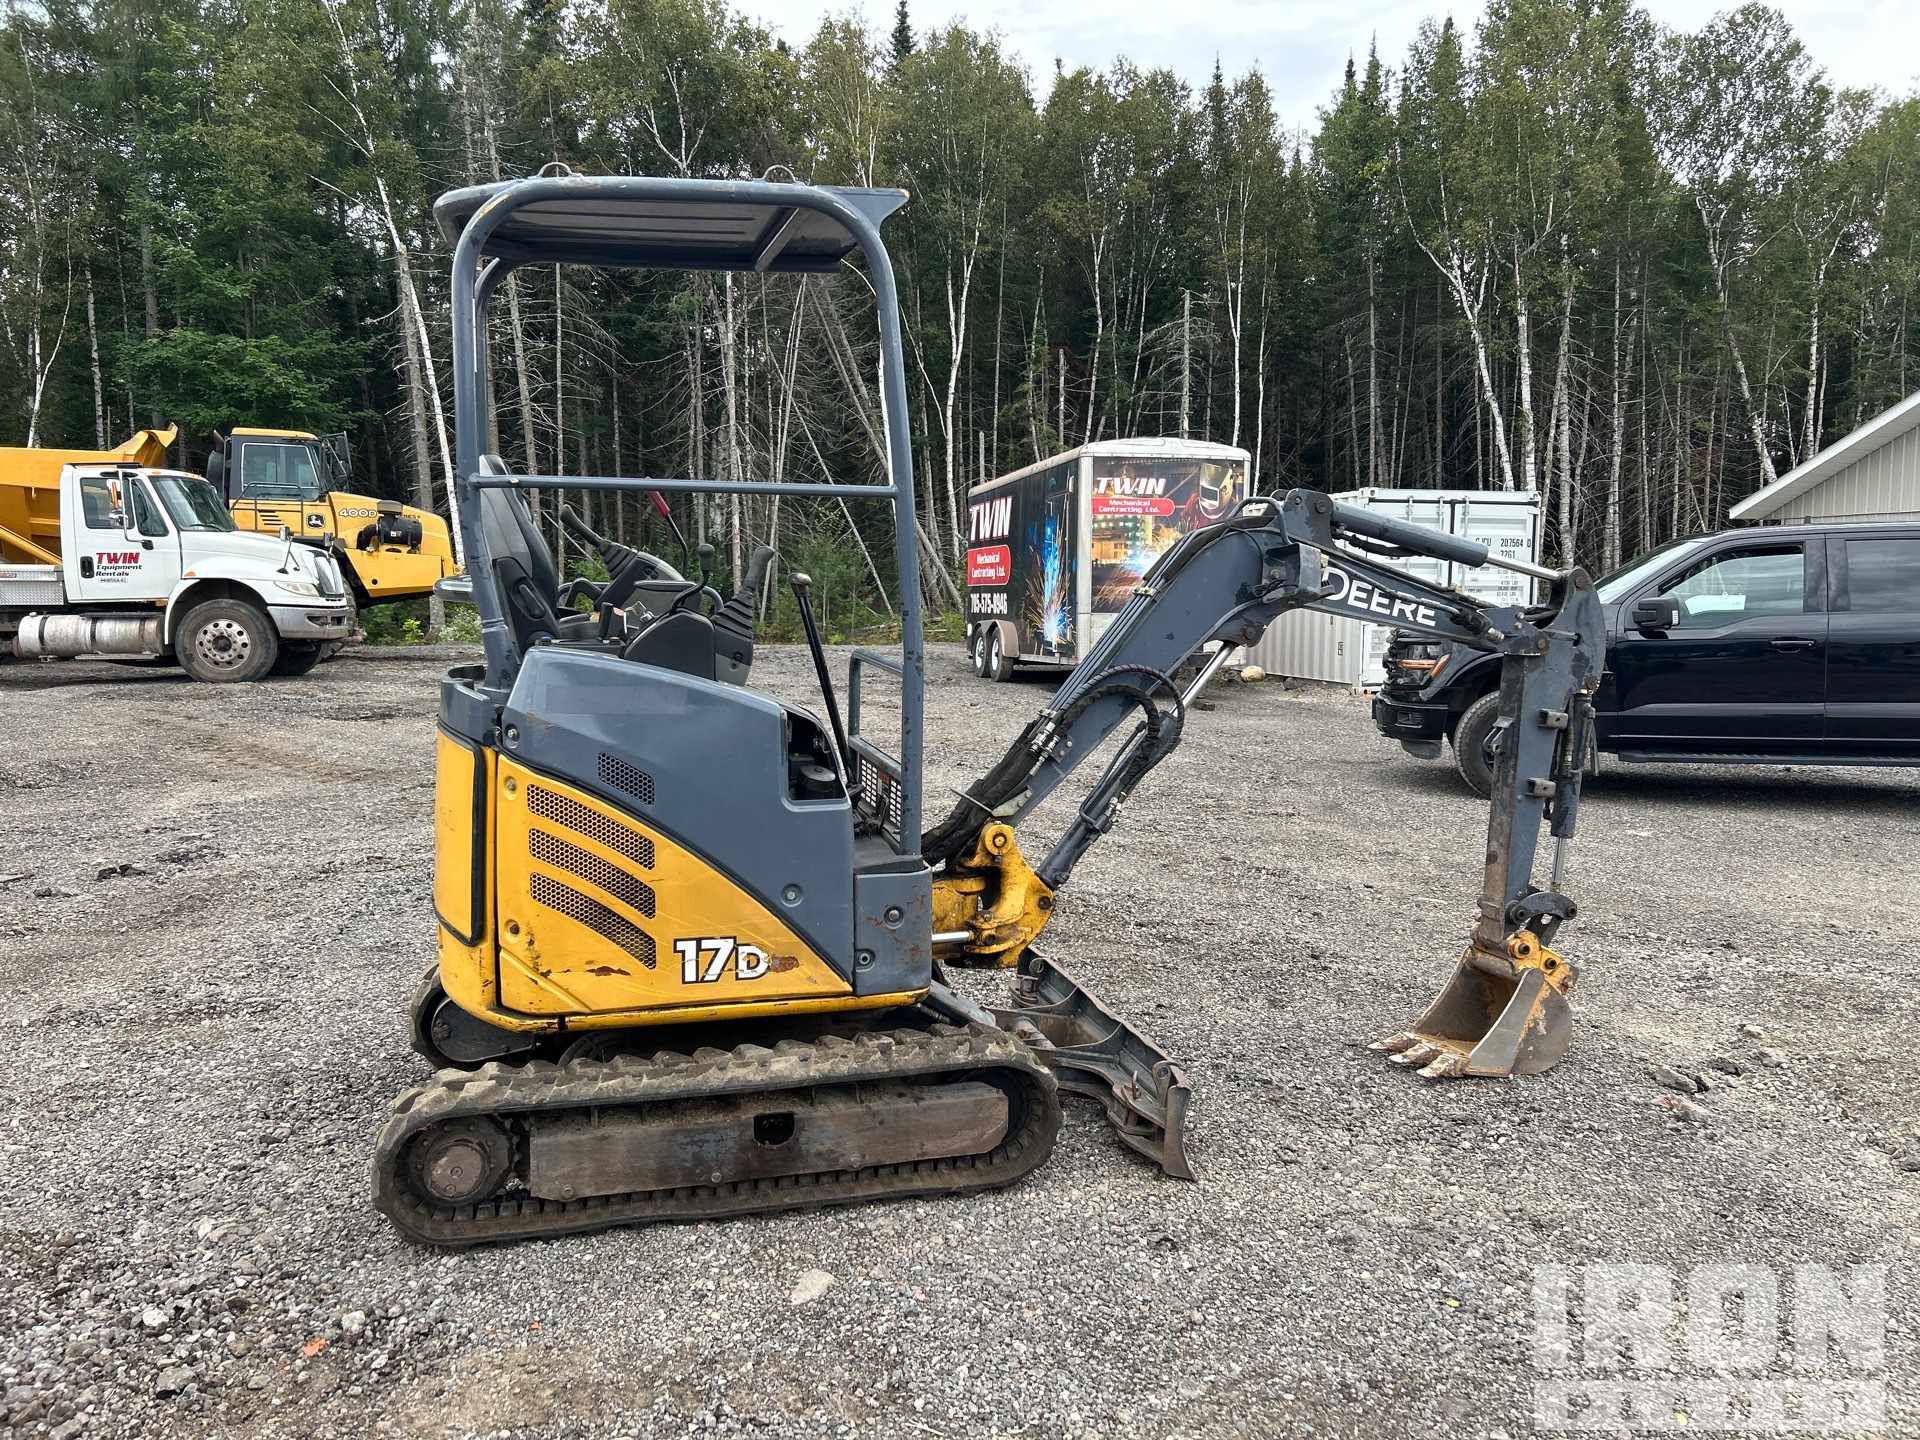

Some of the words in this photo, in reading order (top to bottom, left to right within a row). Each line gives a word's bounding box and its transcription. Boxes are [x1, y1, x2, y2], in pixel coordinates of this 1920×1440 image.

[1096, 477, 1167, 495] TWIN
[339, 508, 378, 518] 400D
[1098, 506, 1143, 514] Contracting
[969, 496, 1012, 543] TWIN
[1500, 538, 1524, 548] 207564
[96, 552, 140, 564] TWIN
[977, 552, 1000, 565] Mechanical
[972, 567, 996, 579] Contracting
[996, 565, 1006, 577] Ltd.
[1321, 566, 1437, 627] DEERE
[673, 936, 770, 984] 17D
